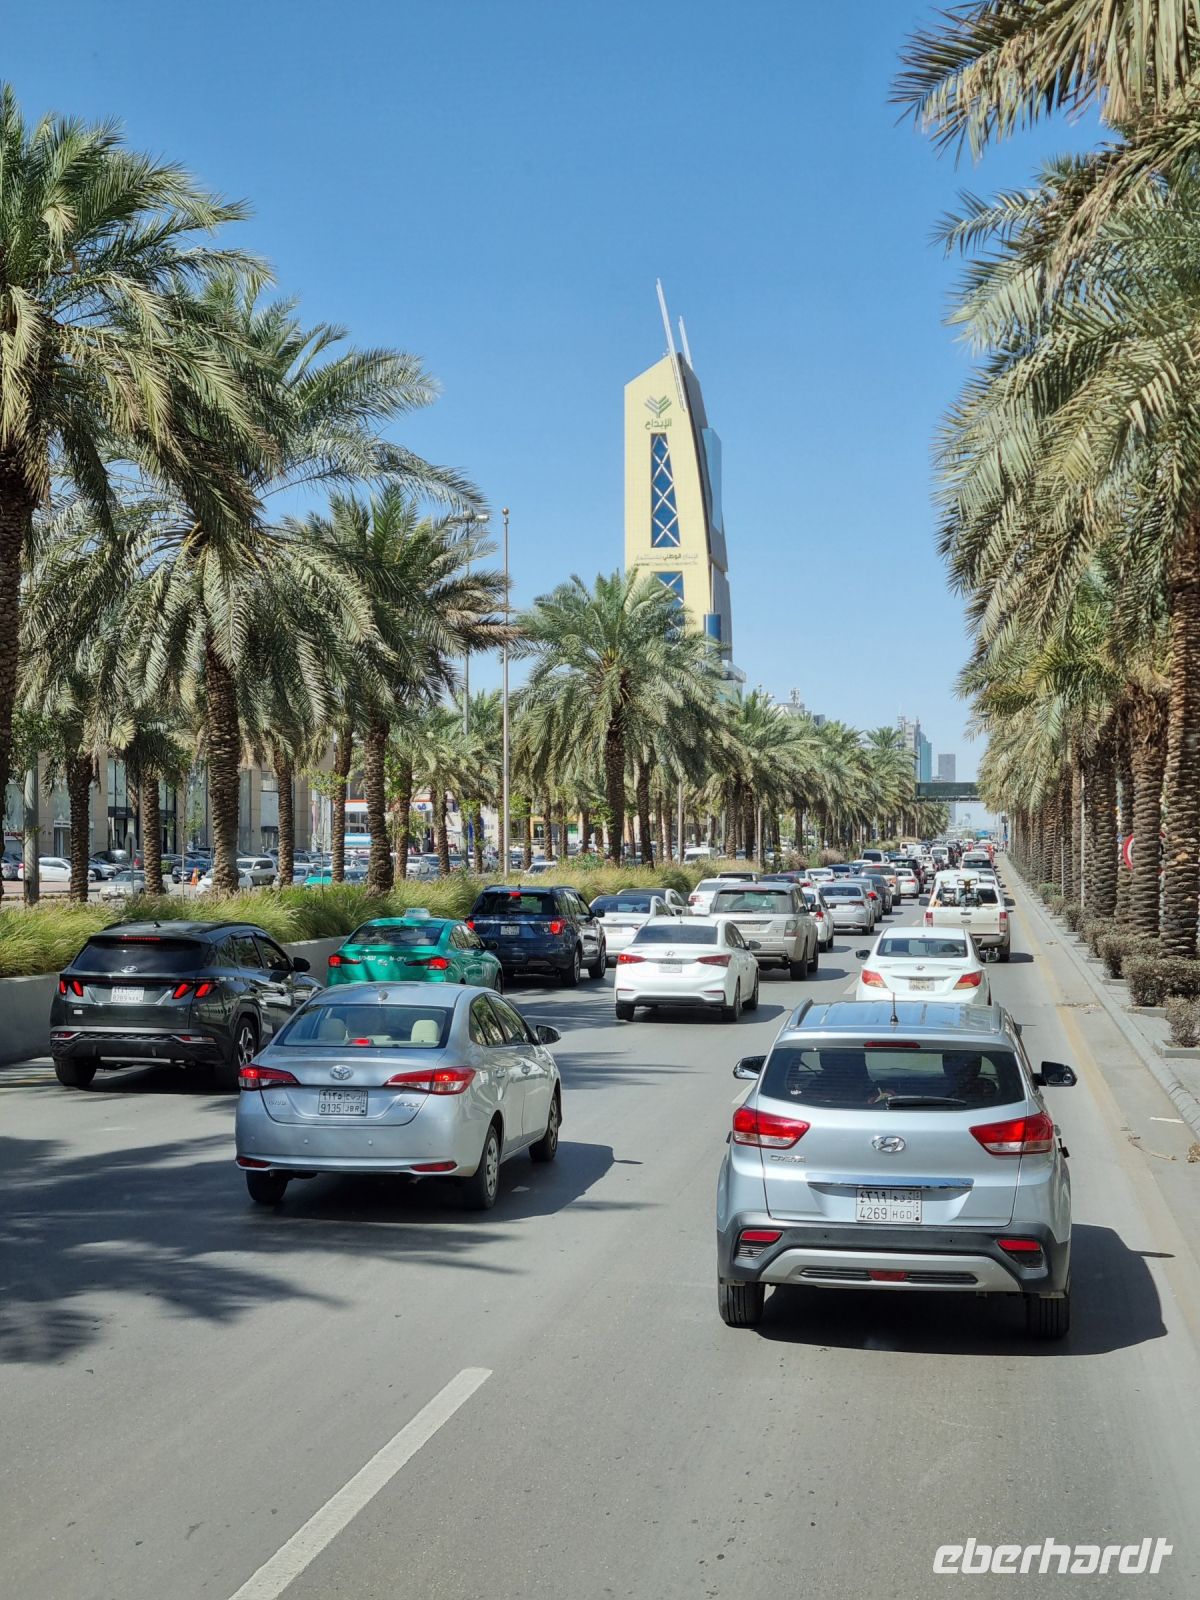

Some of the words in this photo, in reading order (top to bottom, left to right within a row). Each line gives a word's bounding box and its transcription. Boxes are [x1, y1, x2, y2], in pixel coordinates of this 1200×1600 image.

[320, 1103, 342, 1113] 9135
[344, 1105, 360, 1113] JBR
[859, 1206, 888, 1220] 4269
[892, 1210, 912, 1220] HGD
